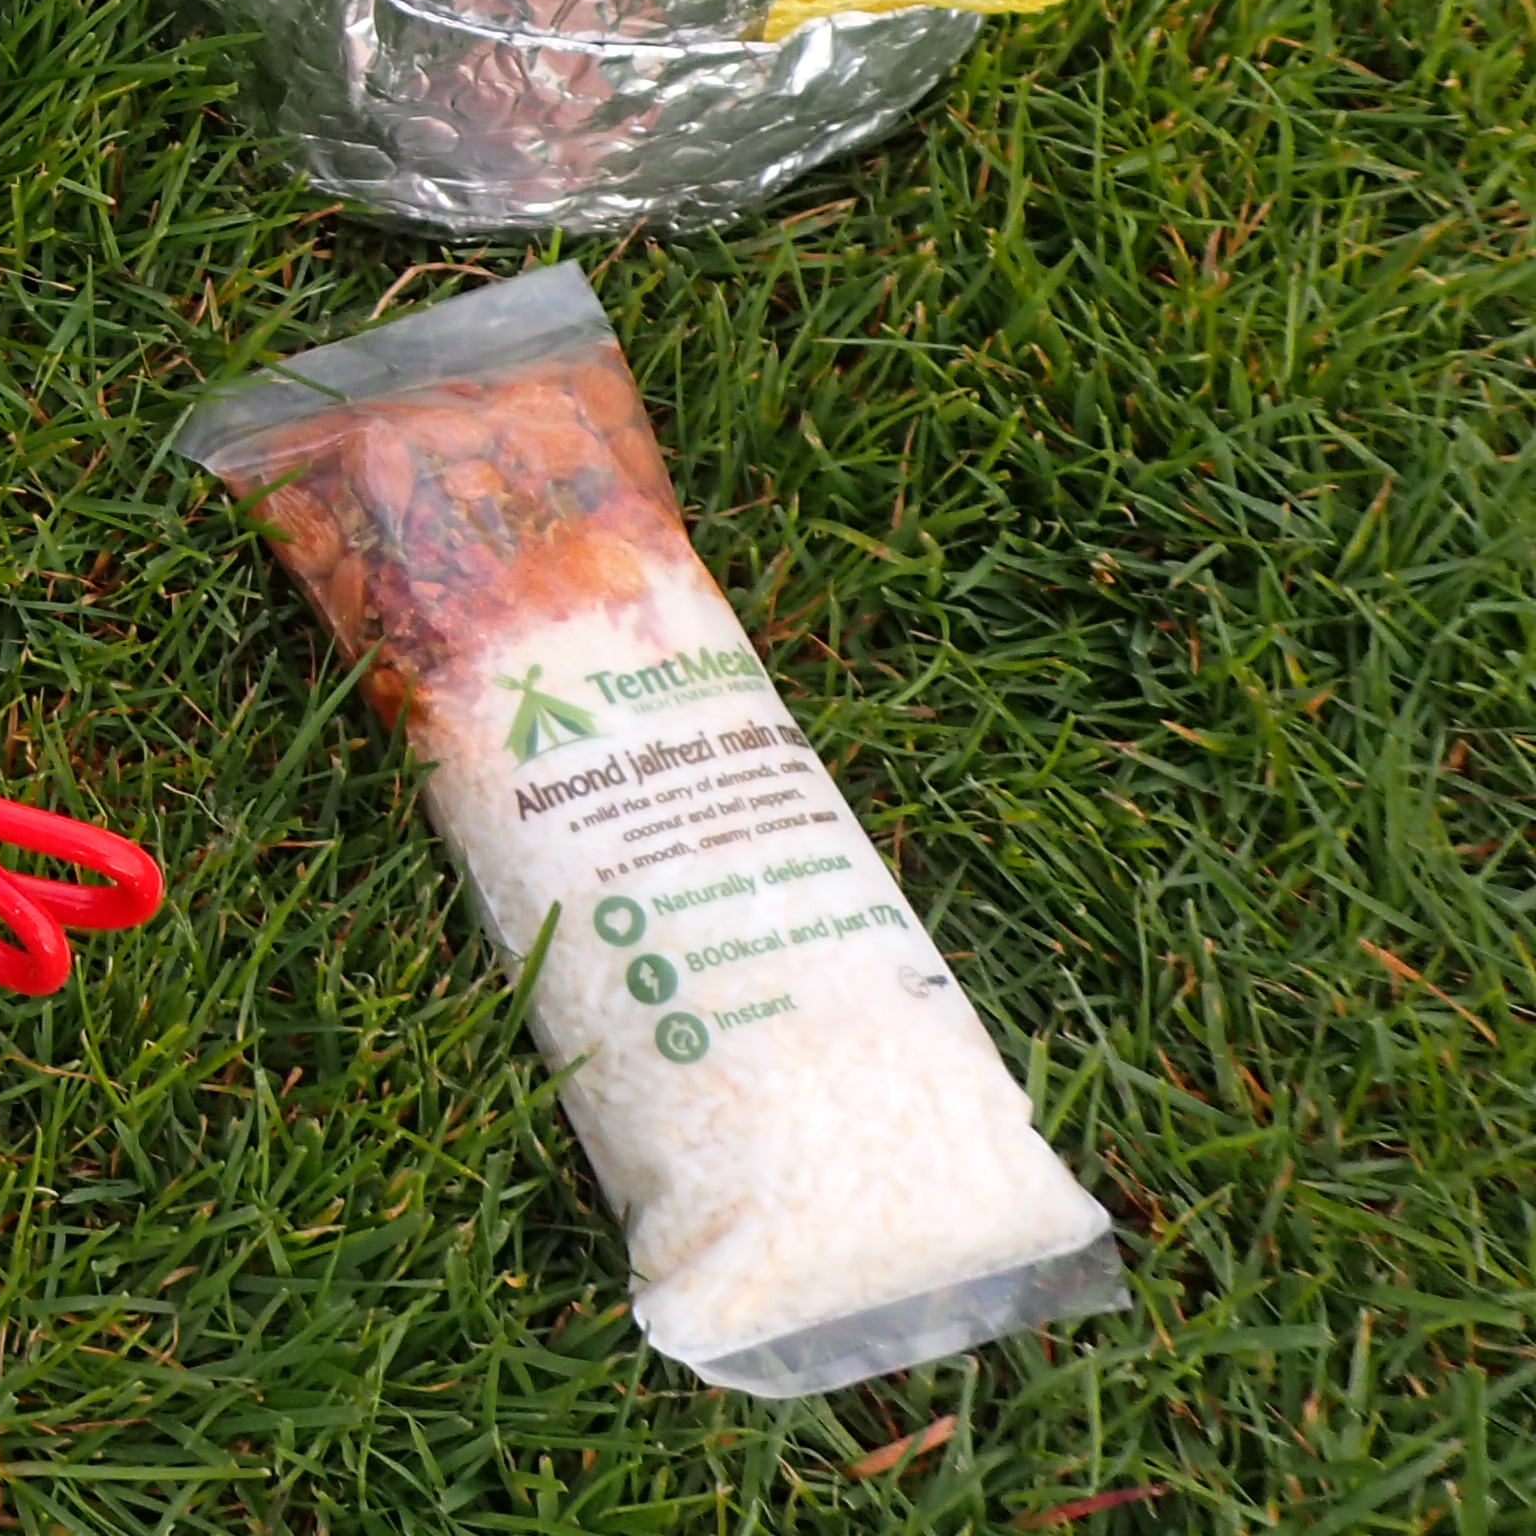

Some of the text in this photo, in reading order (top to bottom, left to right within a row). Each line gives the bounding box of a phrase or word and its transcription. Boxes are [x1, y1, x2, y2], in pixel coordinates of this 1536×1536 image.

[515, 753, 628, 821] Almond
[625, 730, 717, 786] jalfrezi
[718, 720, 778, 755] main
[569, 820, 580, 832] a
[583, 803, 620, 827] mild
[655, 785, 693, 804] curry
[697, 776, 713, 792] of
[623, 814, 685, 842] coconut
[688, 804, 717, 823] and
[618, 862, 629, 874] a
[651, 853, 852, 916] Naturally delicious
[685, 928, 786, 973] 800kcal
[788, 917, 830, 944] and
[830, 911, 870, 941] just
[712, 992, 797, 1030] Instant
